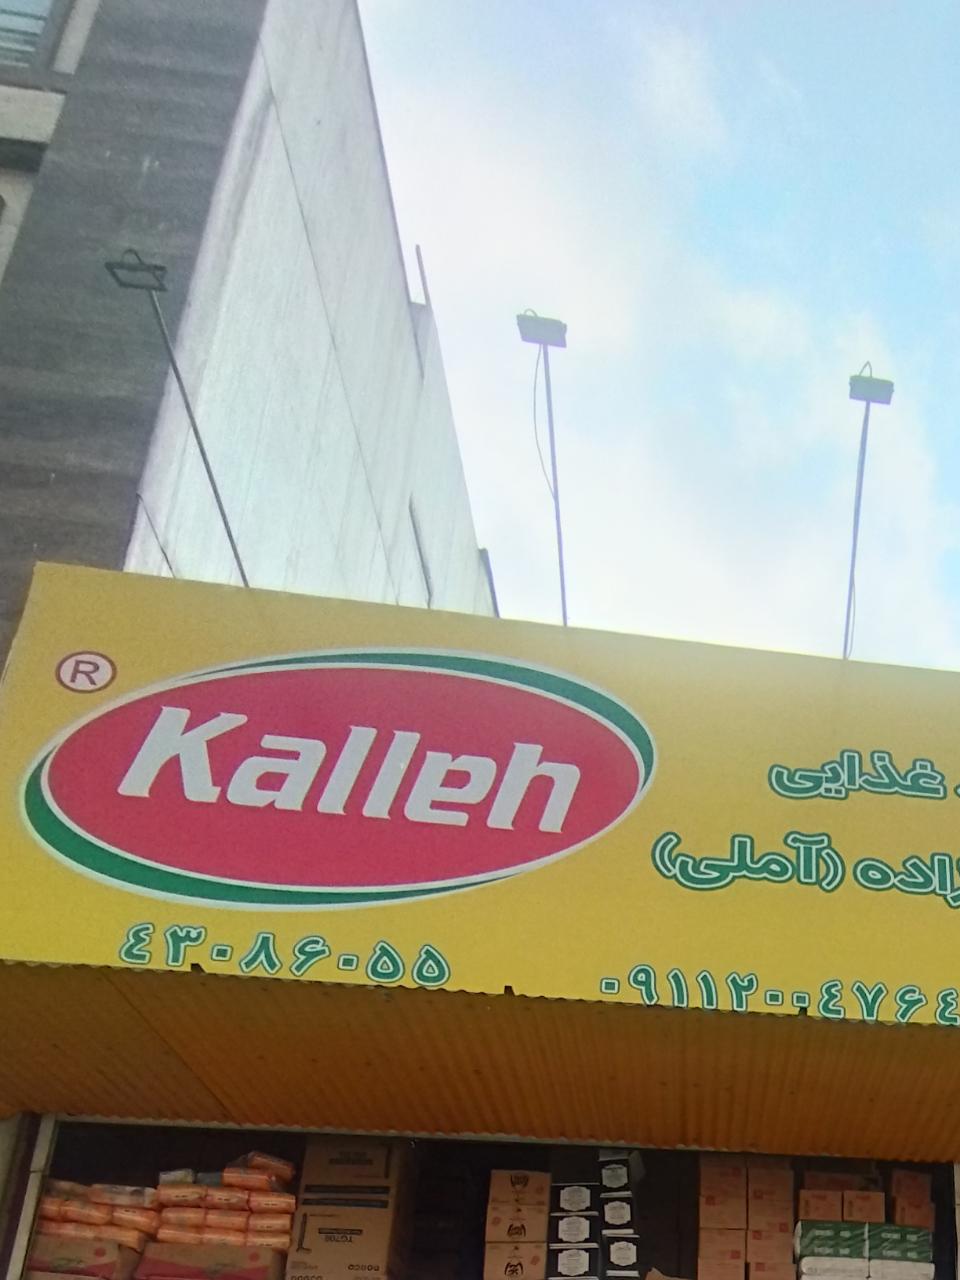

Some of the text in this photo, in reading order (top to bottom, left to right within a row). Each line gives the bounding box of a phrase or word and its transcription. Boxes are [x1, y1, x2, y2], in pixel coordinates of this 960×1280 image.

[116, 705, 582, 834] Kalleh
[769, 751, 946, 799] غذایی
[651, 831, 843, 891] (آملی)
